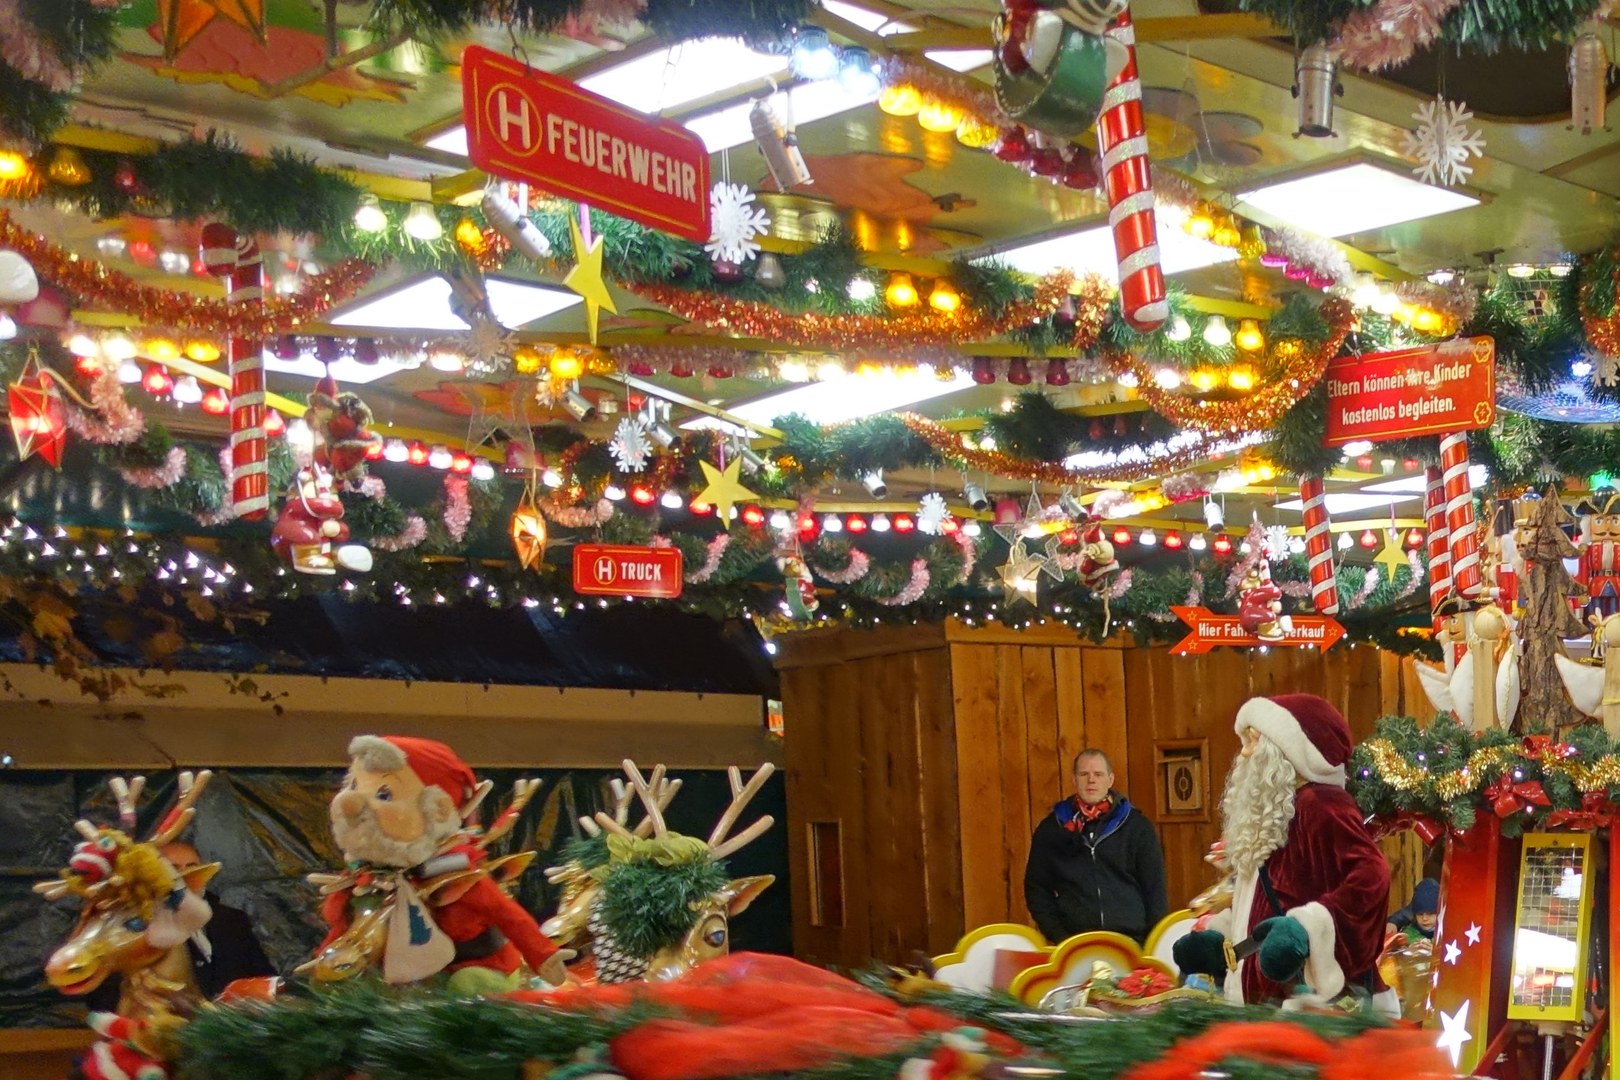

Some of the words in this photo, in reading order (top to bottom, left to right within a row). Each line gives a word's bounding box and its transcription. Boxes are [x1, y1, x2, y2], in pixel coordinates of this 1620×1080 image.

[498, 90, 532, 150] H
[546, 113, 696, 203] FEUERWEHR
[1327, 380, 1360, 398] Eltern
[1363, 373, 1406, 392] können
[1433, 360, 1472, 385] Kinder
[1342, 402, 1396, 425] kostenlos
[1398, 396, 1457, 421] begleiten.
[598, 559, 612, 581] H
[621, 562, 662, 581] TRUCK
[1198, 622, 1221, 637] Hier
